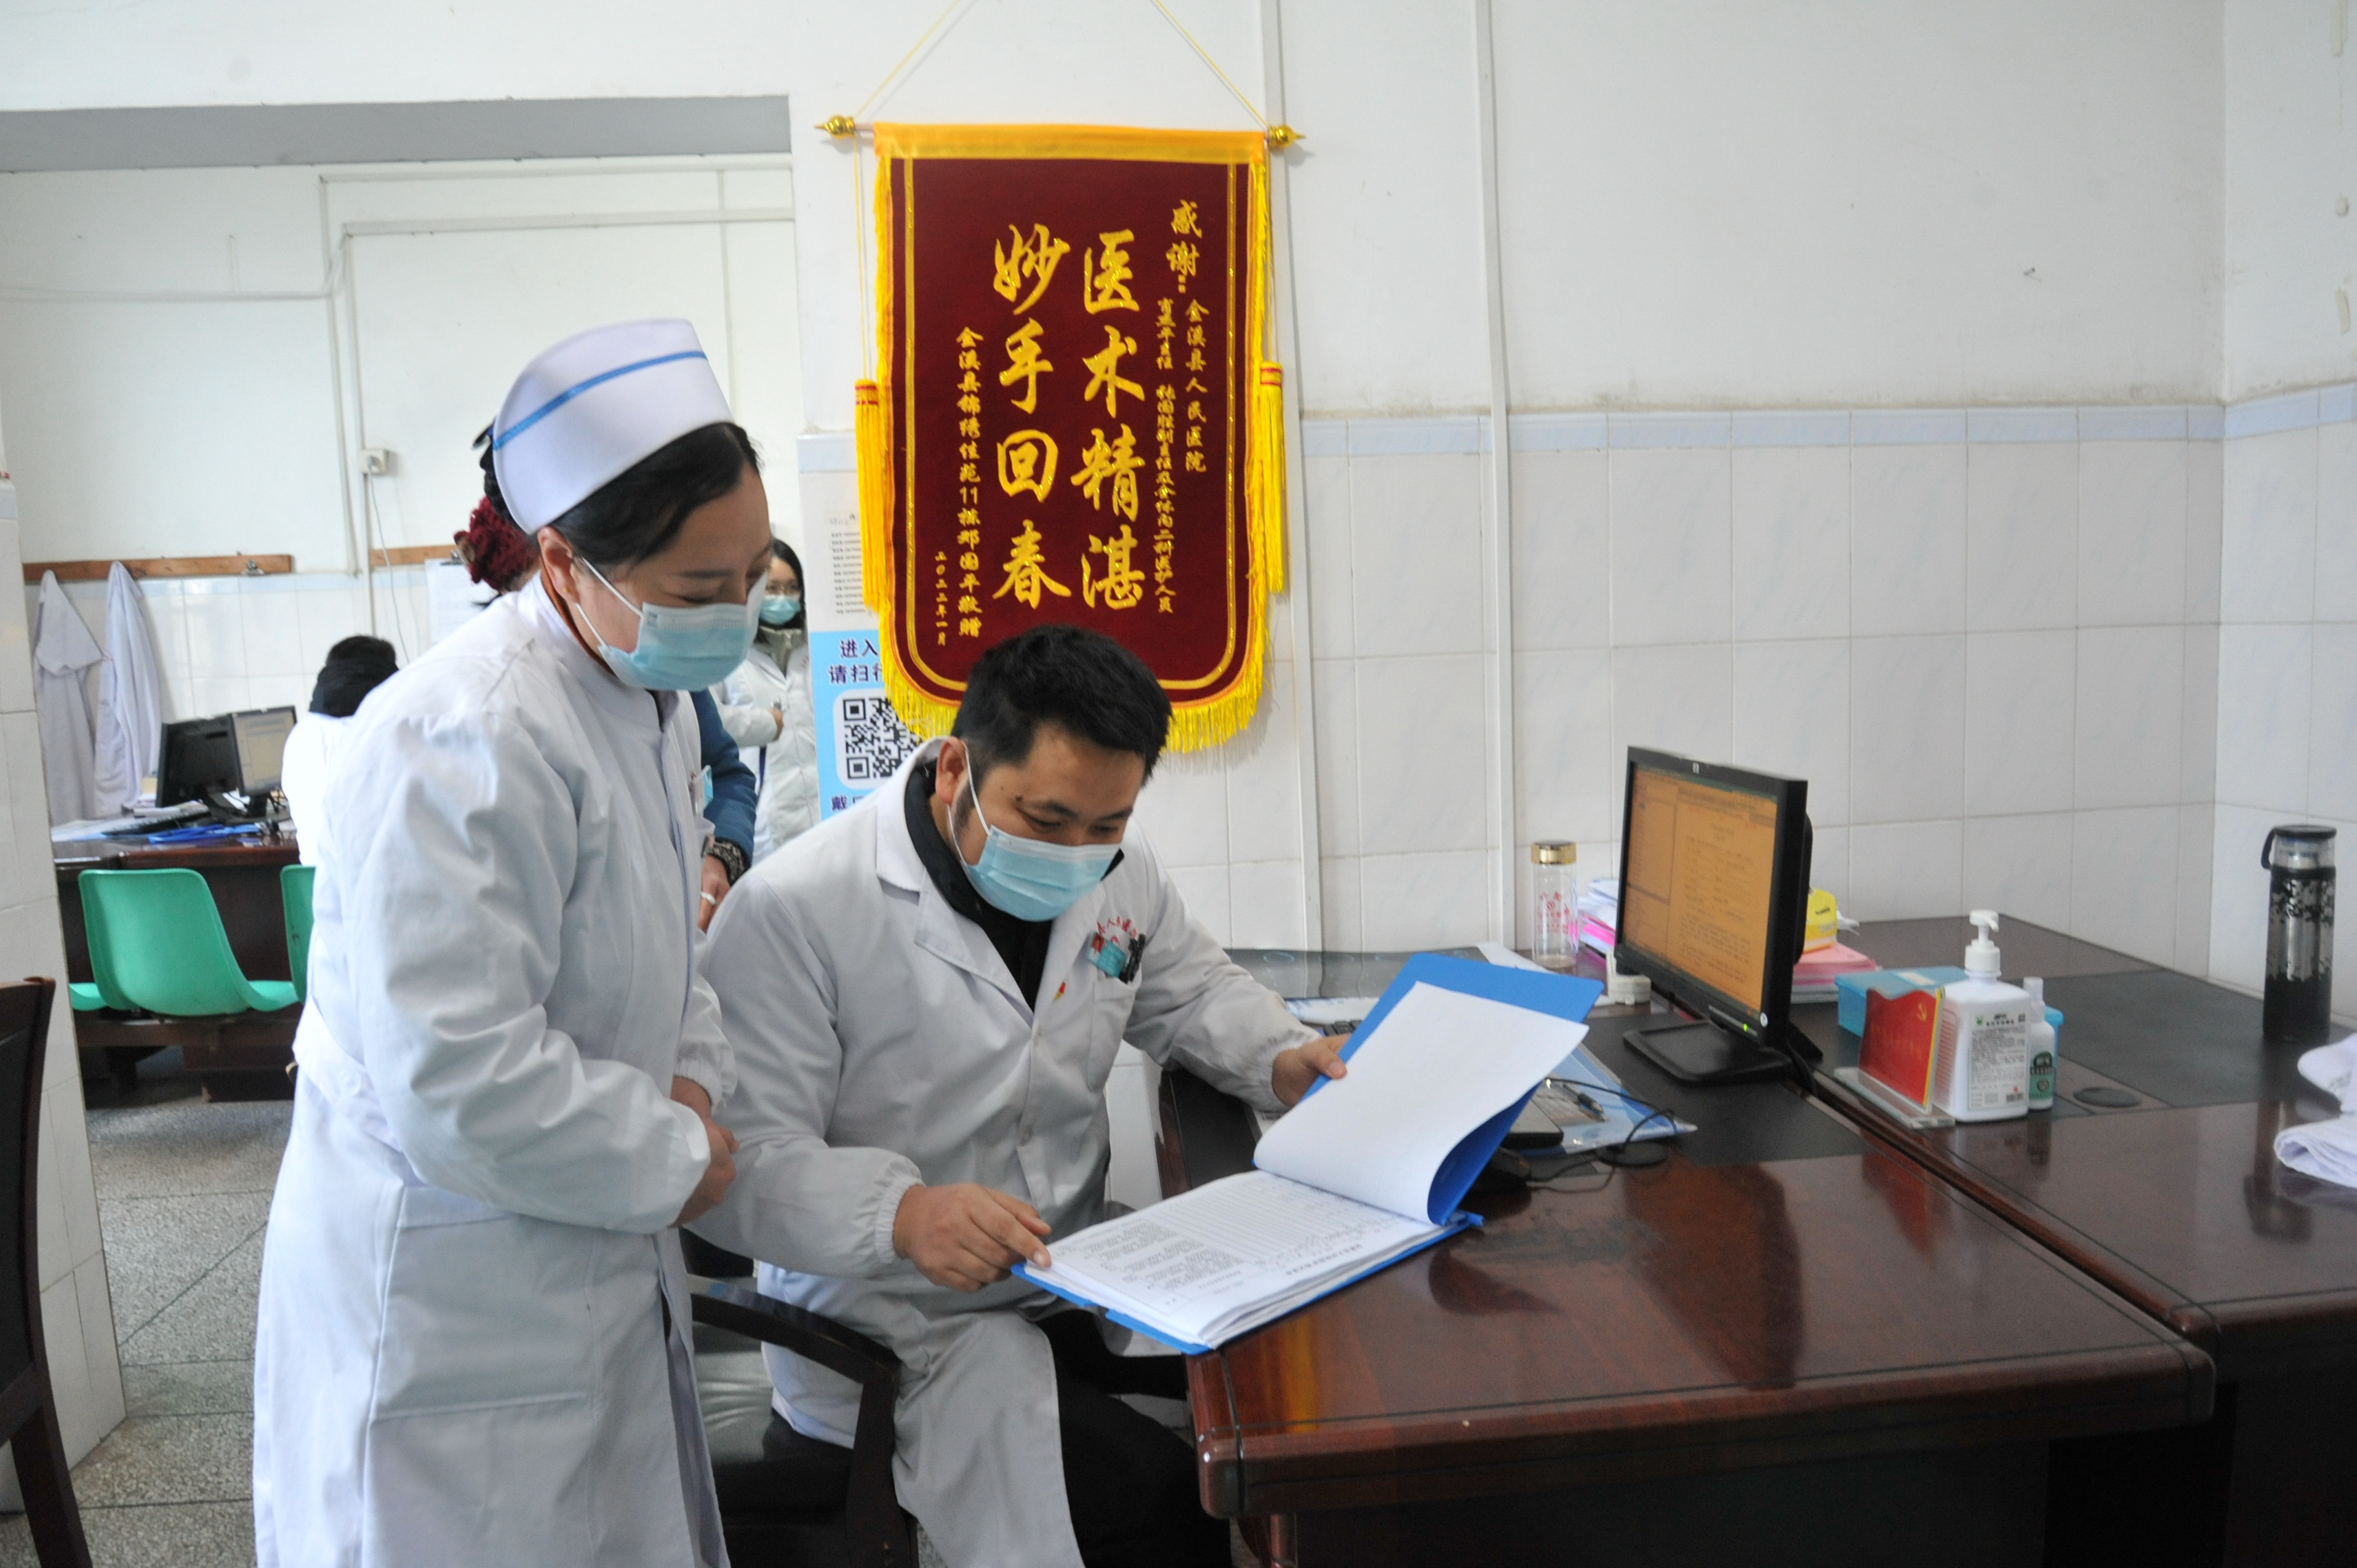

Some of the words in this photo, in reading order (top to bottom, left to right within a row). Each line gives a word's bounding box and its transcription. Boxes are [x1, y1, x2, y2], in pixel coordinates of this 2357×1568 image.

[992, 223, 1071, 609] 妙手回春
[1070, 228, 1146, 610] 医术精湛
[1185, 299, 1210, 472] 金溪县人民医院
[840, 639, 878, 657] 进入
